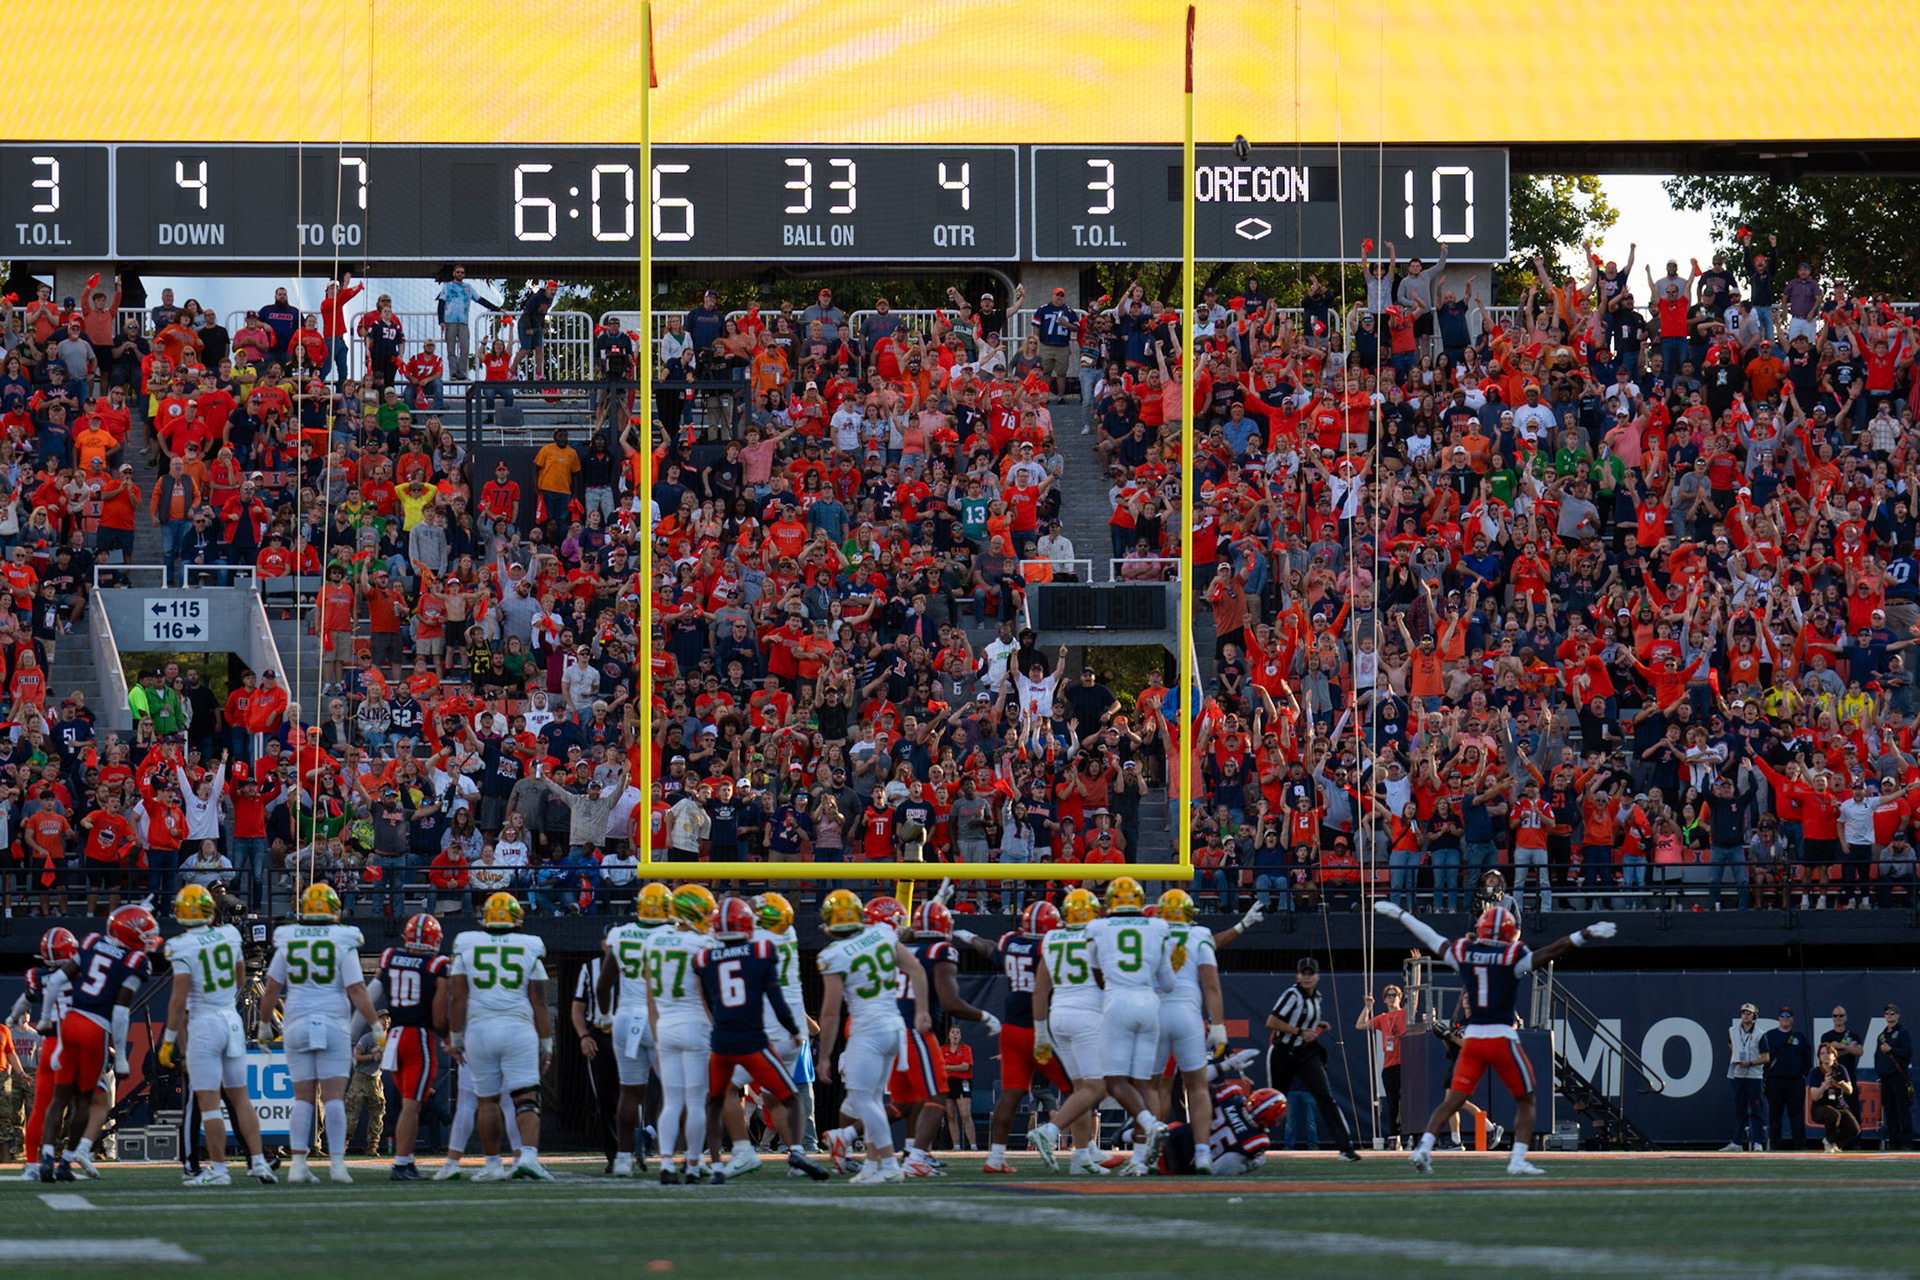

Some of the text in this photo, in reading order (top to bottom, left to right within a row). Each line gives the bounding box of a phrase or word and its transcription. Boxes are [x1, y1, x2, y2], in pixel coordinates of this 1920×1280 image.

[31, 156, 60, 213] 3
[175, 159, 208, 210] 4
[339, 157, 368, 210] 7
[784, 157, 857, 214] 33
[938, 161, 971, 211] 4
[1086, 158, 1115, 215] 3
[1195, 165, 1310, 203] OREGON
[513, 163, 695, 242] 6:06
[1404, 165, 1474, 243] 10
[15, 223, 73, 246] T.O.L.
[158, 223, 225, 246] DOWN
[297, 223, 362, 246] TO GO
[783, 224, 855, 246] BALL ON
[933, 224, 976, 248] QTR
[1071, 225, 1127, 247] T.O.L.
[382, 327, 397, 340] 50
[1579, 340, 1588, 356] 9
[417, 364, 434, 376] 77
[1000, 412, 1016, 430] 78
[492, 489, 511, 506] 77
[966, 506, 986, 524] 13
[170, 601, 200, 618] 115
[153, 622, 184, 639] 116
[953, 681, 961, 695] 6
[391, 708, 413, 727] 52
[875, 822, 885, 835] 11
[1299, 816, 1309, 829] 2
[285, 939, 336, 985] 59
[472, 945, 526, 991] 55
[710, 945, 752, 962] CLARKE
[1048, 940, 1090, 985] 75
[1116, 928, 1143, 973] 9
[80, 953, 113, 997] 5
[197, 942, 236, 995] 19
[717, 959, 748, 1009] 6
[849, 943, 898, 1001] 39
[1004, 953, 1036, 993] 96
[387, 967, 422, 1008] 10
[1472, 965, 1490, 1008] 1
[1223, 1104, 1249, 1136] KANTE
